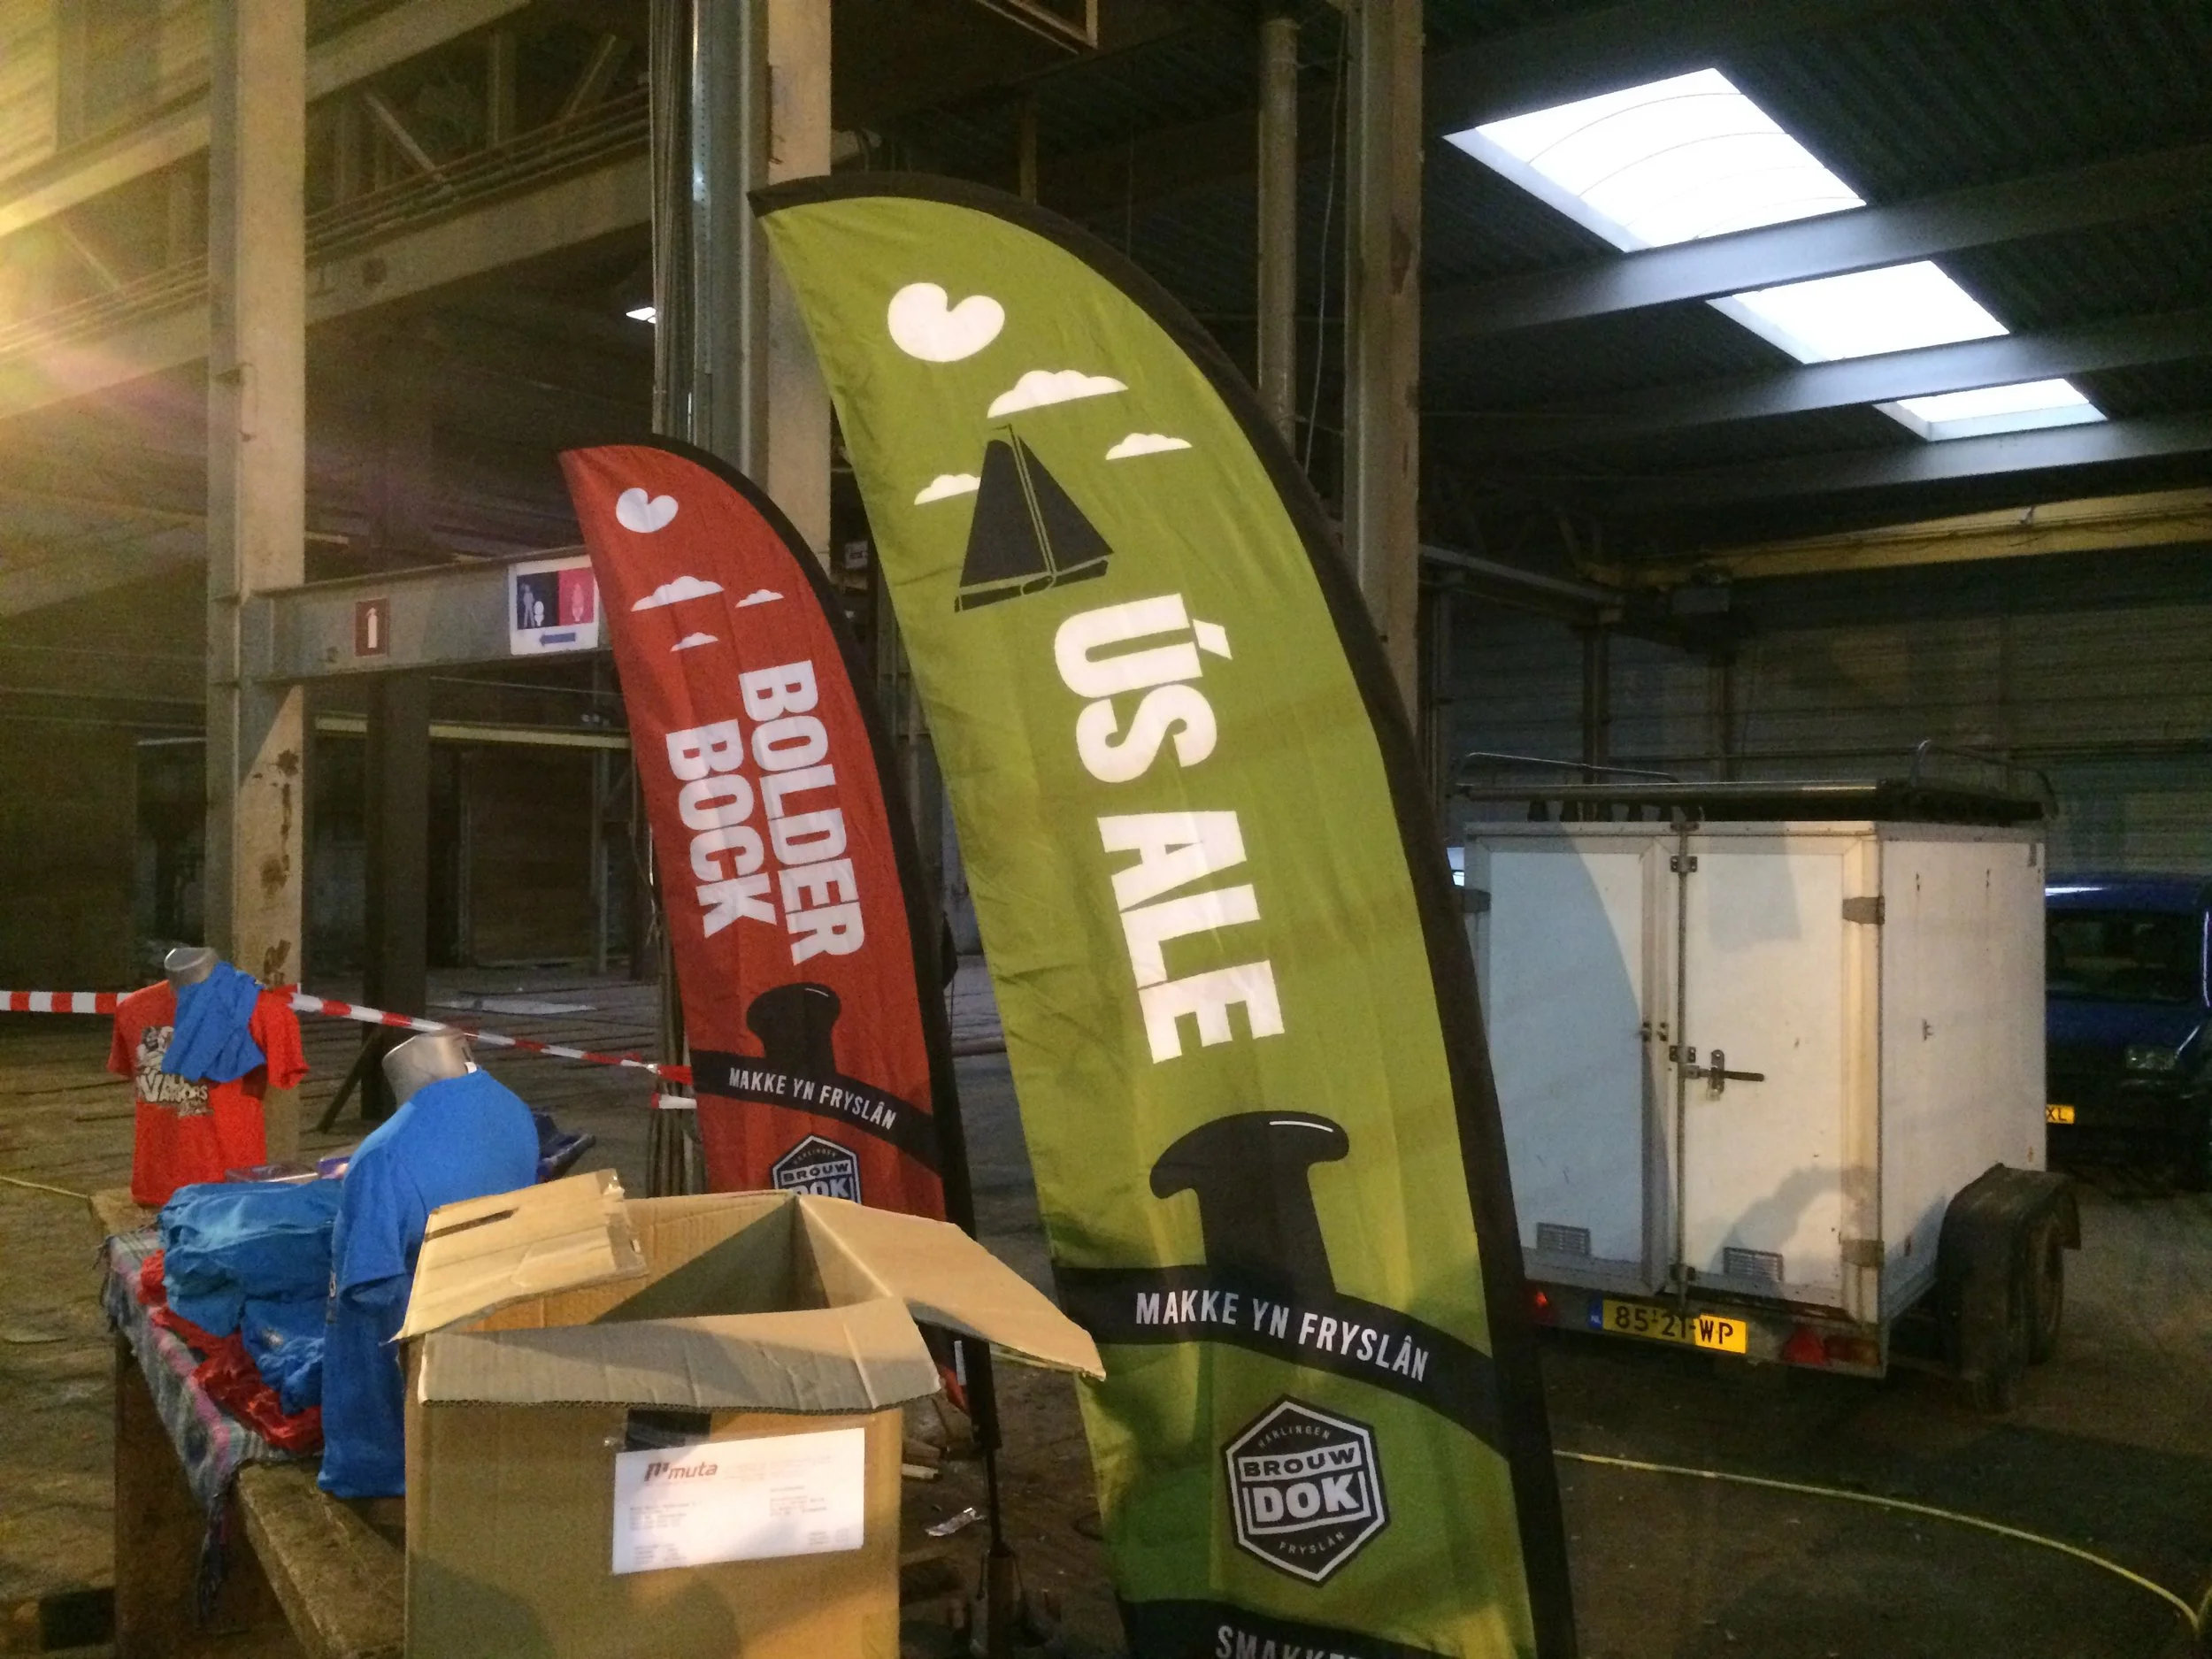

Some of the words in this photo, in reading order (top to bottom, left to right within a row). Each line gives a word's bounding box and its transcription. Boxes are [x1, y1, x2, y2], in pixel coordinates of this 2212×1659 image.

[1054, 592, 1233, 784] ÚS
[665, 718, 778, 939] BOCK
[739, 659, 866, 966] BOLDER
[1096, 810, 1286, 1064] ALE
[728, 1066, 787, 1095] MAKKE
[793, 1077, 816, 1102] YN
[818, 1084, 897, 1131] FRYSLÂN
[782, 1163, 849, 1183] BROUW
[1135, 1288, 1240, 1325] MAKKE
[1251, 1298, 1290, 1340] YN
[1297, 1311, 1430, 1383] FRYSLÂN
[1243, 1447, 1356, 1478] BROUW
[1252, 1471, 1361, 1523] DOK
